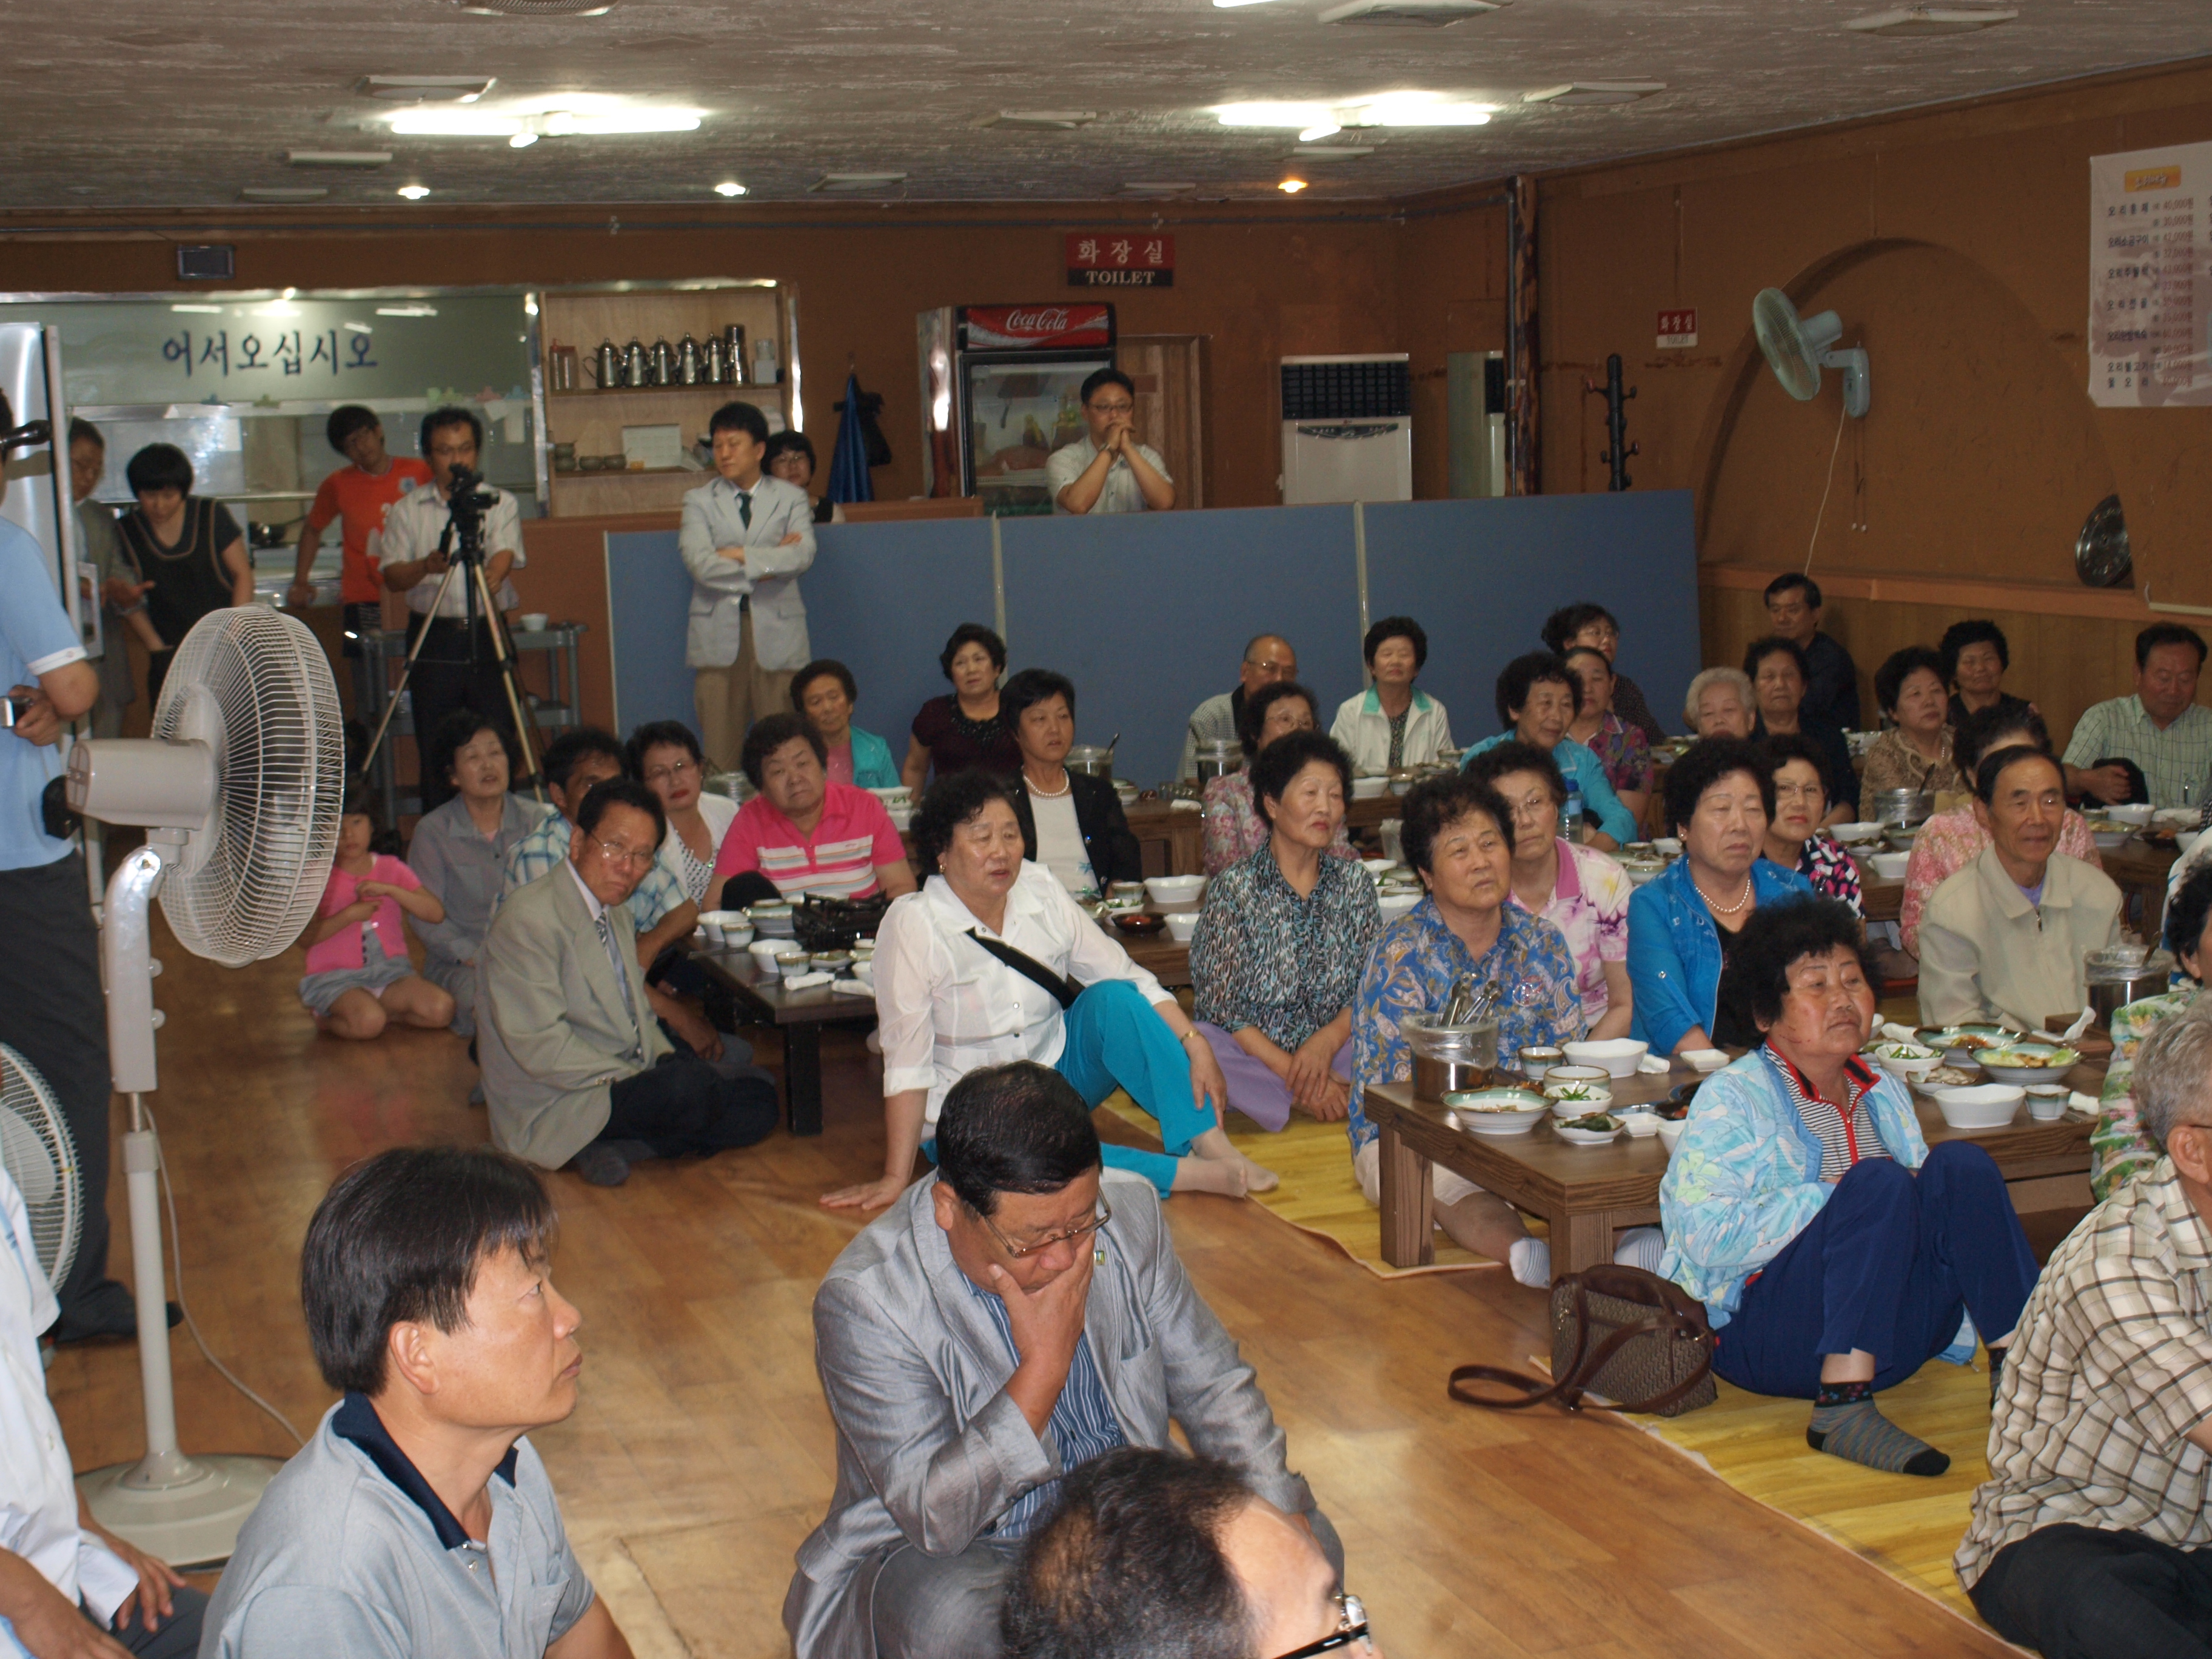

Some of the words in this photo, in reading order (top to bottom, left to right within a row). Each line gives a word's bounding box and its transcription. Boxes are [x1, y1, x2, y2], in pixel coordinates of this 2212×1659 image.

[1078, 240, 1164, 265] 화장실
[1086, 270, 1155, 284] TOILET
[161, 329, 378, 377] 어서오십시오
